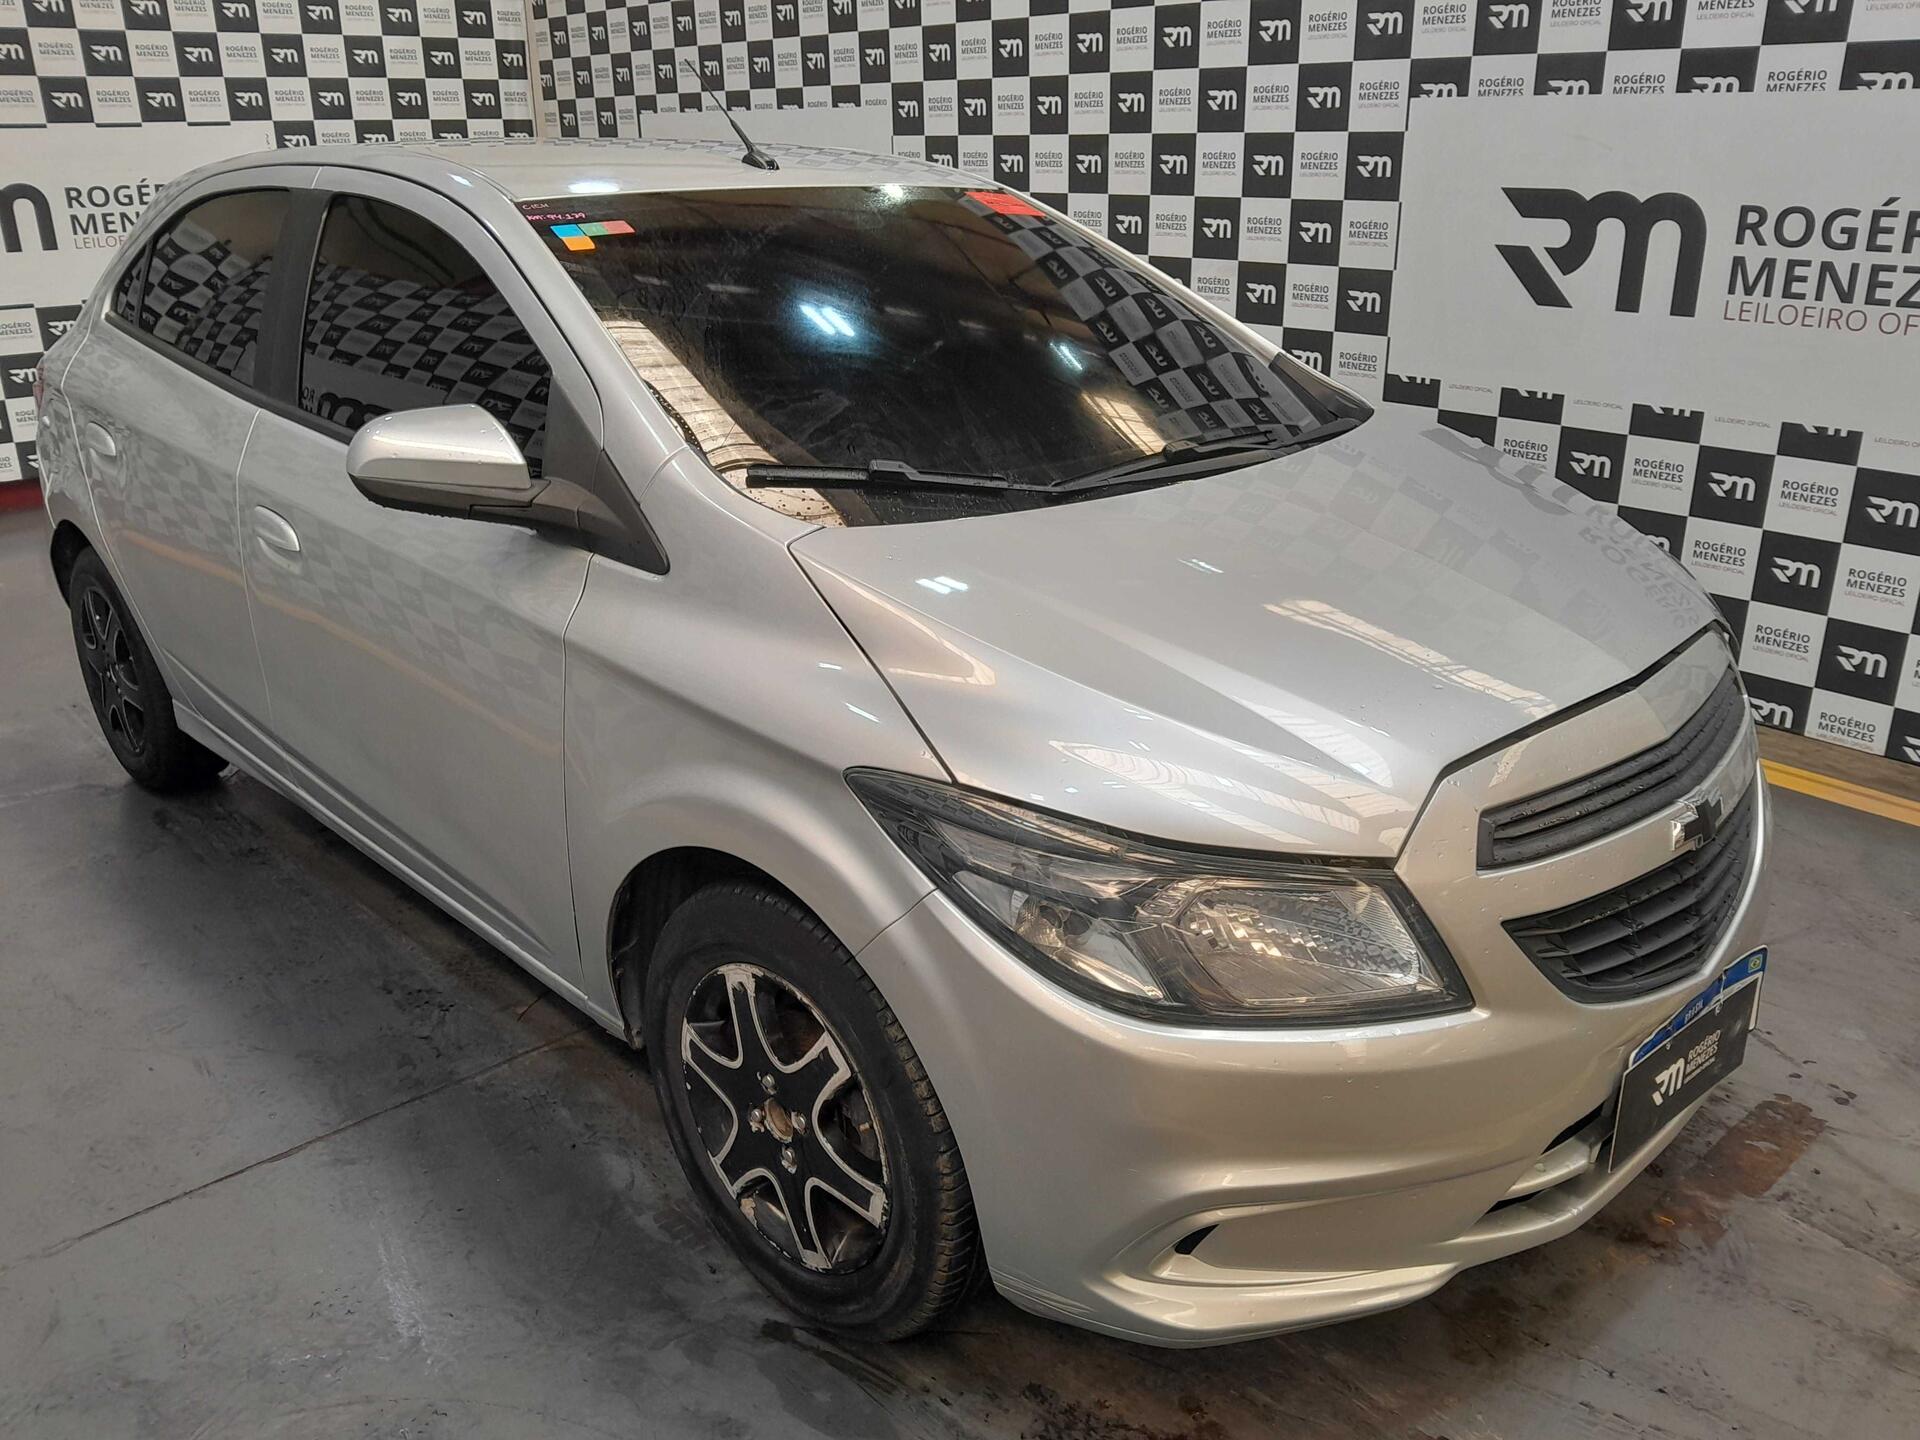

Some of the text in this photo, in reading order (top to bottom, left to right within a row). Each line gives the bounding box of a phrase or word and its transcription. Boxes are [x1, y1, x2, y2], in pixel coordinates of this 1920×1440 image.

[1423, 2, 1466, 15] ROGÉRIO
[1551, 7, 1601, 18] MENEZES
[1308, 11, 1348, 23] ROGÉRIO
[1422, 14, 1466, 25] MENEZES
[1207, 18, 1242, 29] ROGÉRIO
[1308, 22, 1347, 32] MENEZES
[1117, 26, 1147, 36] ROGÉRIO
[1207, 28, 1242, 38] MENEZES
[1035, 32, 1063, 41] ROGÉRIO
[1116, 35, 1148, 44] MENEZES
[894, 43, 917, 51] ROGÉRIO
[961, 38, 986, 46] ROGÉRIO
[1035, 41, 1063, 50] MENEZES
[961, 46, 987, 54] MENEZES
[1614, 72, 1665, 85] ROGÉRIO
[1768, 68, 1827, 82] ROGÉRIO
[1359, 80, 1400, 91] ROGÉRIO
[1478, 76, 1524, 88] ROGÉRIO
[1159, 88, 1191, 96] ROGÉRIO
[1253, 84, 1289, 94] ROGÉRIO
[928, 96, 952, 104] ROGÉRIO
[998, 94, 1024, 102] ROGÉRIO
[1074, 91, 1103, 100] ROGÉRIO
[1253, 94, 1289, 103] MENEZES
[1358, 91, 1399, 100] MENEZES
[1074, 100, 1104, 108] MENEZES
[1159, 97, 1191, 105] MENEZES
[1035, 151, 1062, 159] ROGÉRIO
[1115, 151, 1144, 160] ROGÉRIO
[1202, 151, 1236, 160] ROGÉRIO
[1301, 151, 1338, 160] ROGÉRIO
[1035, 160, 1062, 168] MENEZES
[1114, 160, 1144, 168] MENEZES
[1202, 161, 1236, 169] MENEZES
[1300, 162, 1338, 170] MENEZES
[64, 178, 165, 208] ROGÉ
[1074, 210, 1102, 218] ROGÉRIO
[1156, 213, 1187, 222] ROGÉRIO
[1247, 216, 1282, 226] ROGÉRIO
[1349, 220, 1388, 230] ROGÉRIO
[1156, 222, 1186, 231] MENEZES
[1247, 226, 1282, 235] MENEZES
[1349, 230, 1388, 240] MENEZES
[1198, 277, 1230, 286] ROGÉRIO
[1197, 286, 1230, 295] MENEZES
[1293, 283, 1329, 294] ROGÉRIO
[1292, 292, 1328, 302] MENEZES
[1723, 301, 1867, 332] LEILOEIRO
[1339, 352, 1377, 363] ROGÉRIO
[1339, 361, 1377, 372] MENEZES
[1504, 438, 1548, 452] ROGÉRIO
[1634, 458, 1684, 473] ROGÉRIO
[1633, 468, 1683, 483] MENEZES
[1782, 480, 1839, 496] ROGÉRIO
[1780, 490, 1838, 507] MENEZES
[1694, 540, 1746, 557] ROGÉRIO
[1693, 550, 1745, 567] MENEZES
[1848, 568, 1907, 587] ROGÉRIO
[1846, 578, 1906, 598] MENEZES
[1756, 624, 1810, 643] ROGÉRIO
[1754, 634, 1809, 654] MENEZES
[1820, 712, 1876, 733] ROGÉRIO
[1818, 722, 1874, 743] MENEZES
[1687, 1030, 1720, 1062] ROGÉRIO
[1685, 1042, 1718, 1075] MENEZES
